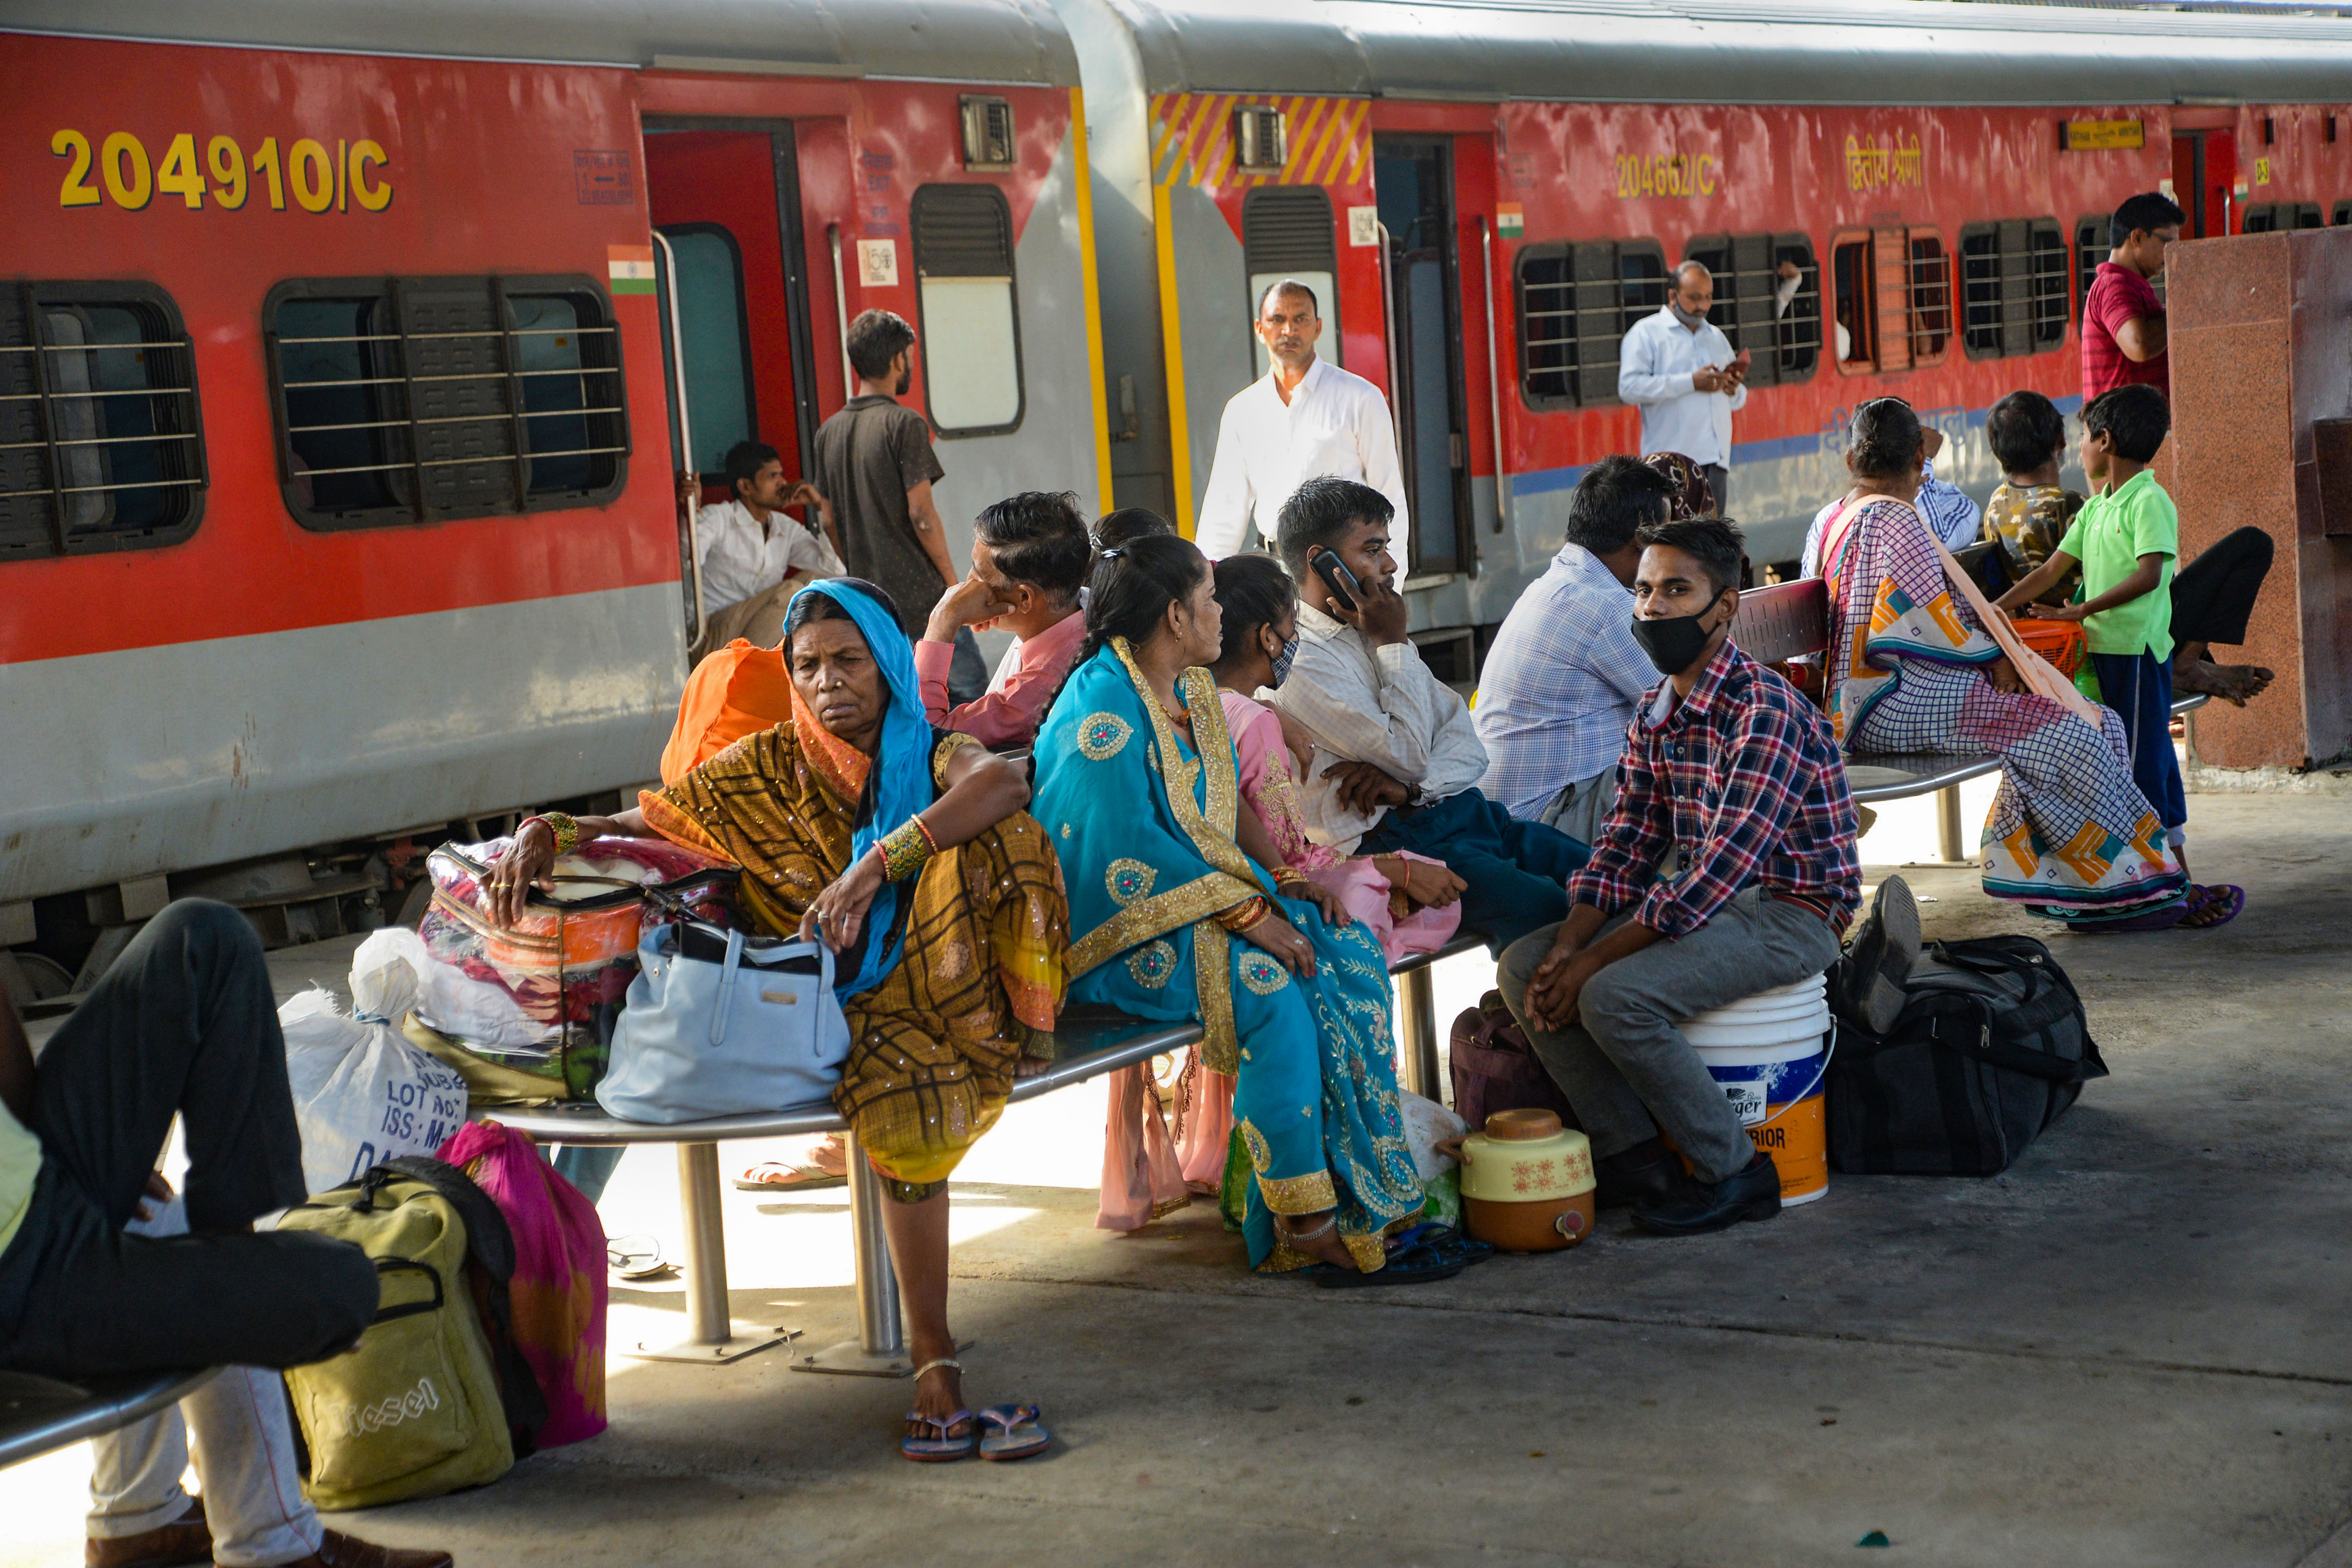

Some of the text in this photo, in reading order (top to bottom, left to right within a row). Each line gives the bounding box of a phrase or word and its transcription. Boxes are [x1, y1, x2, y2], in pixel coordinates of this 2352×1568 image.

[51, 128, 393, 214] 204910/C
[1617, 153, 1715, 198] 204662/C
[1845, 133, 1922, 192] द्वितीय श्रेणी
[387, 1080, 427, 1110] LOT
[1733, 1101, 1762, 1118] ger
[1746, 1127, 1786, 1149] RIOR
